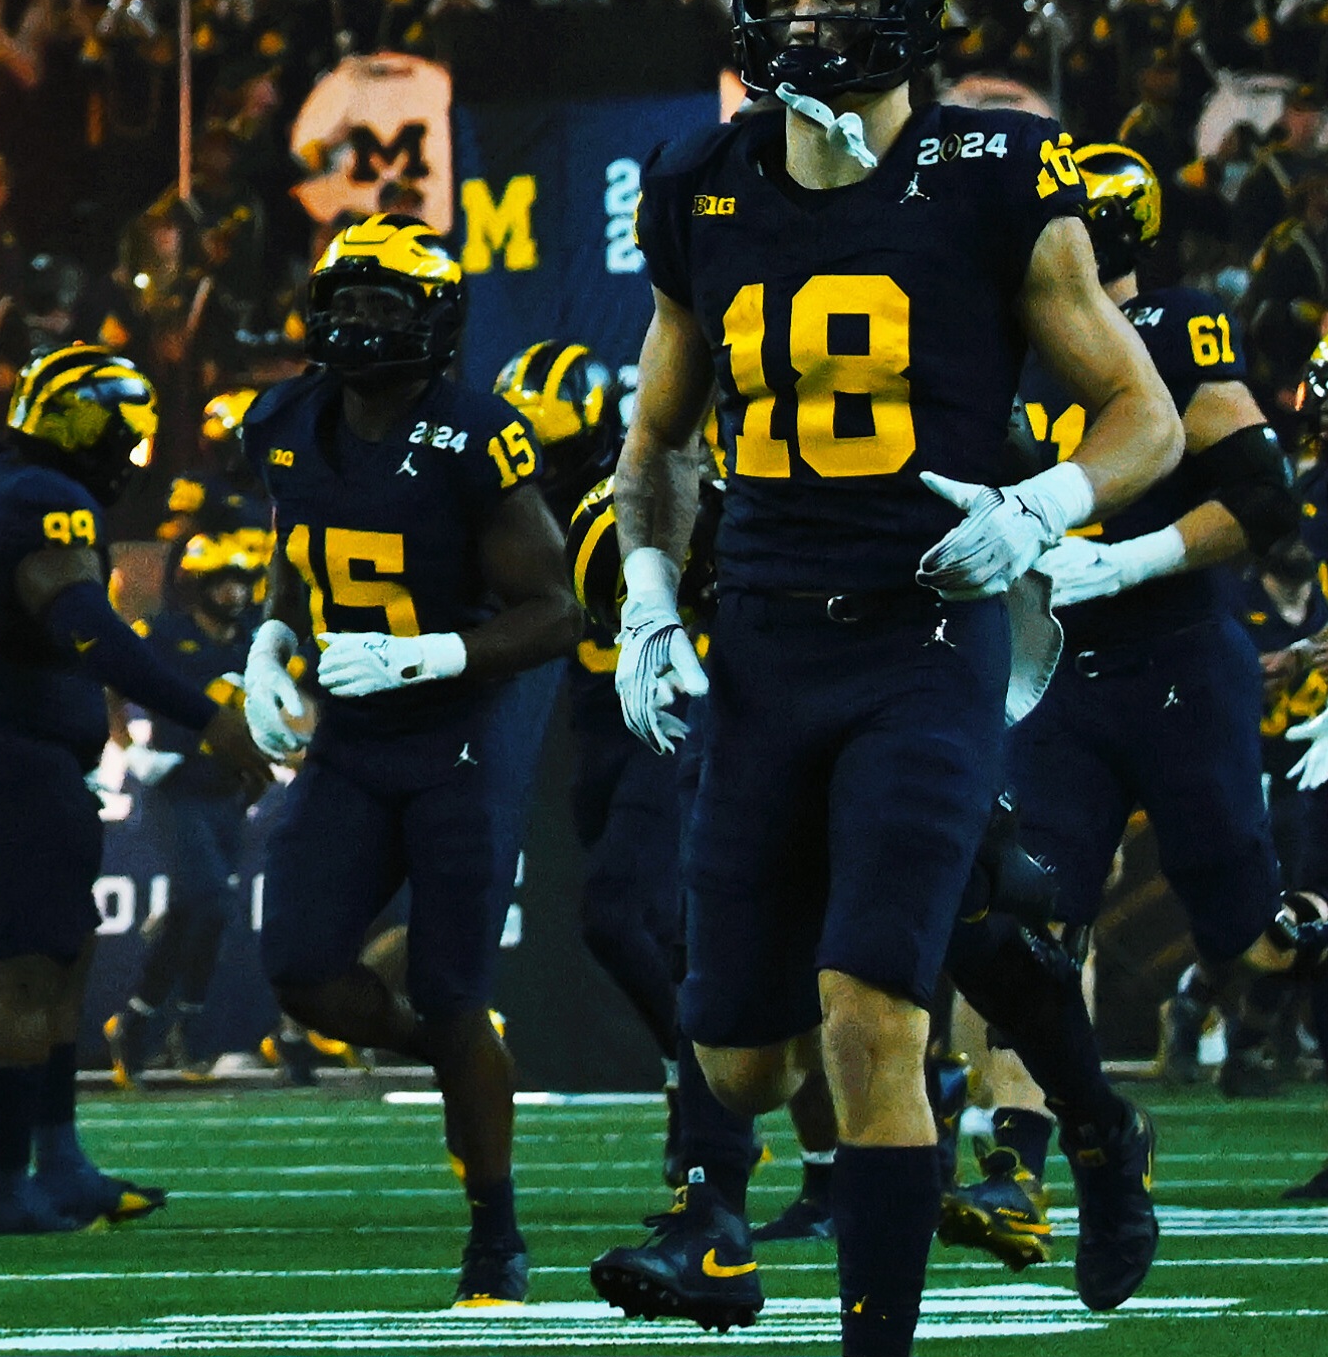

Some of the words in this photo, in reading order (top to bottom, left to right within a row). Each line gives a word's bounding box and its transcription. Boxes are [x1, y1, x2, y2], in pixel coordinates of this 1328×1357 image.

[348, 124, 430, 182] M
[460, 174, 540, 275] M
[721, 274, 916, 478] 18
[1187, 313, 1236, 367] 61
[486, 419, 536, 489] 15
[286, 522, 421, 652] 15
